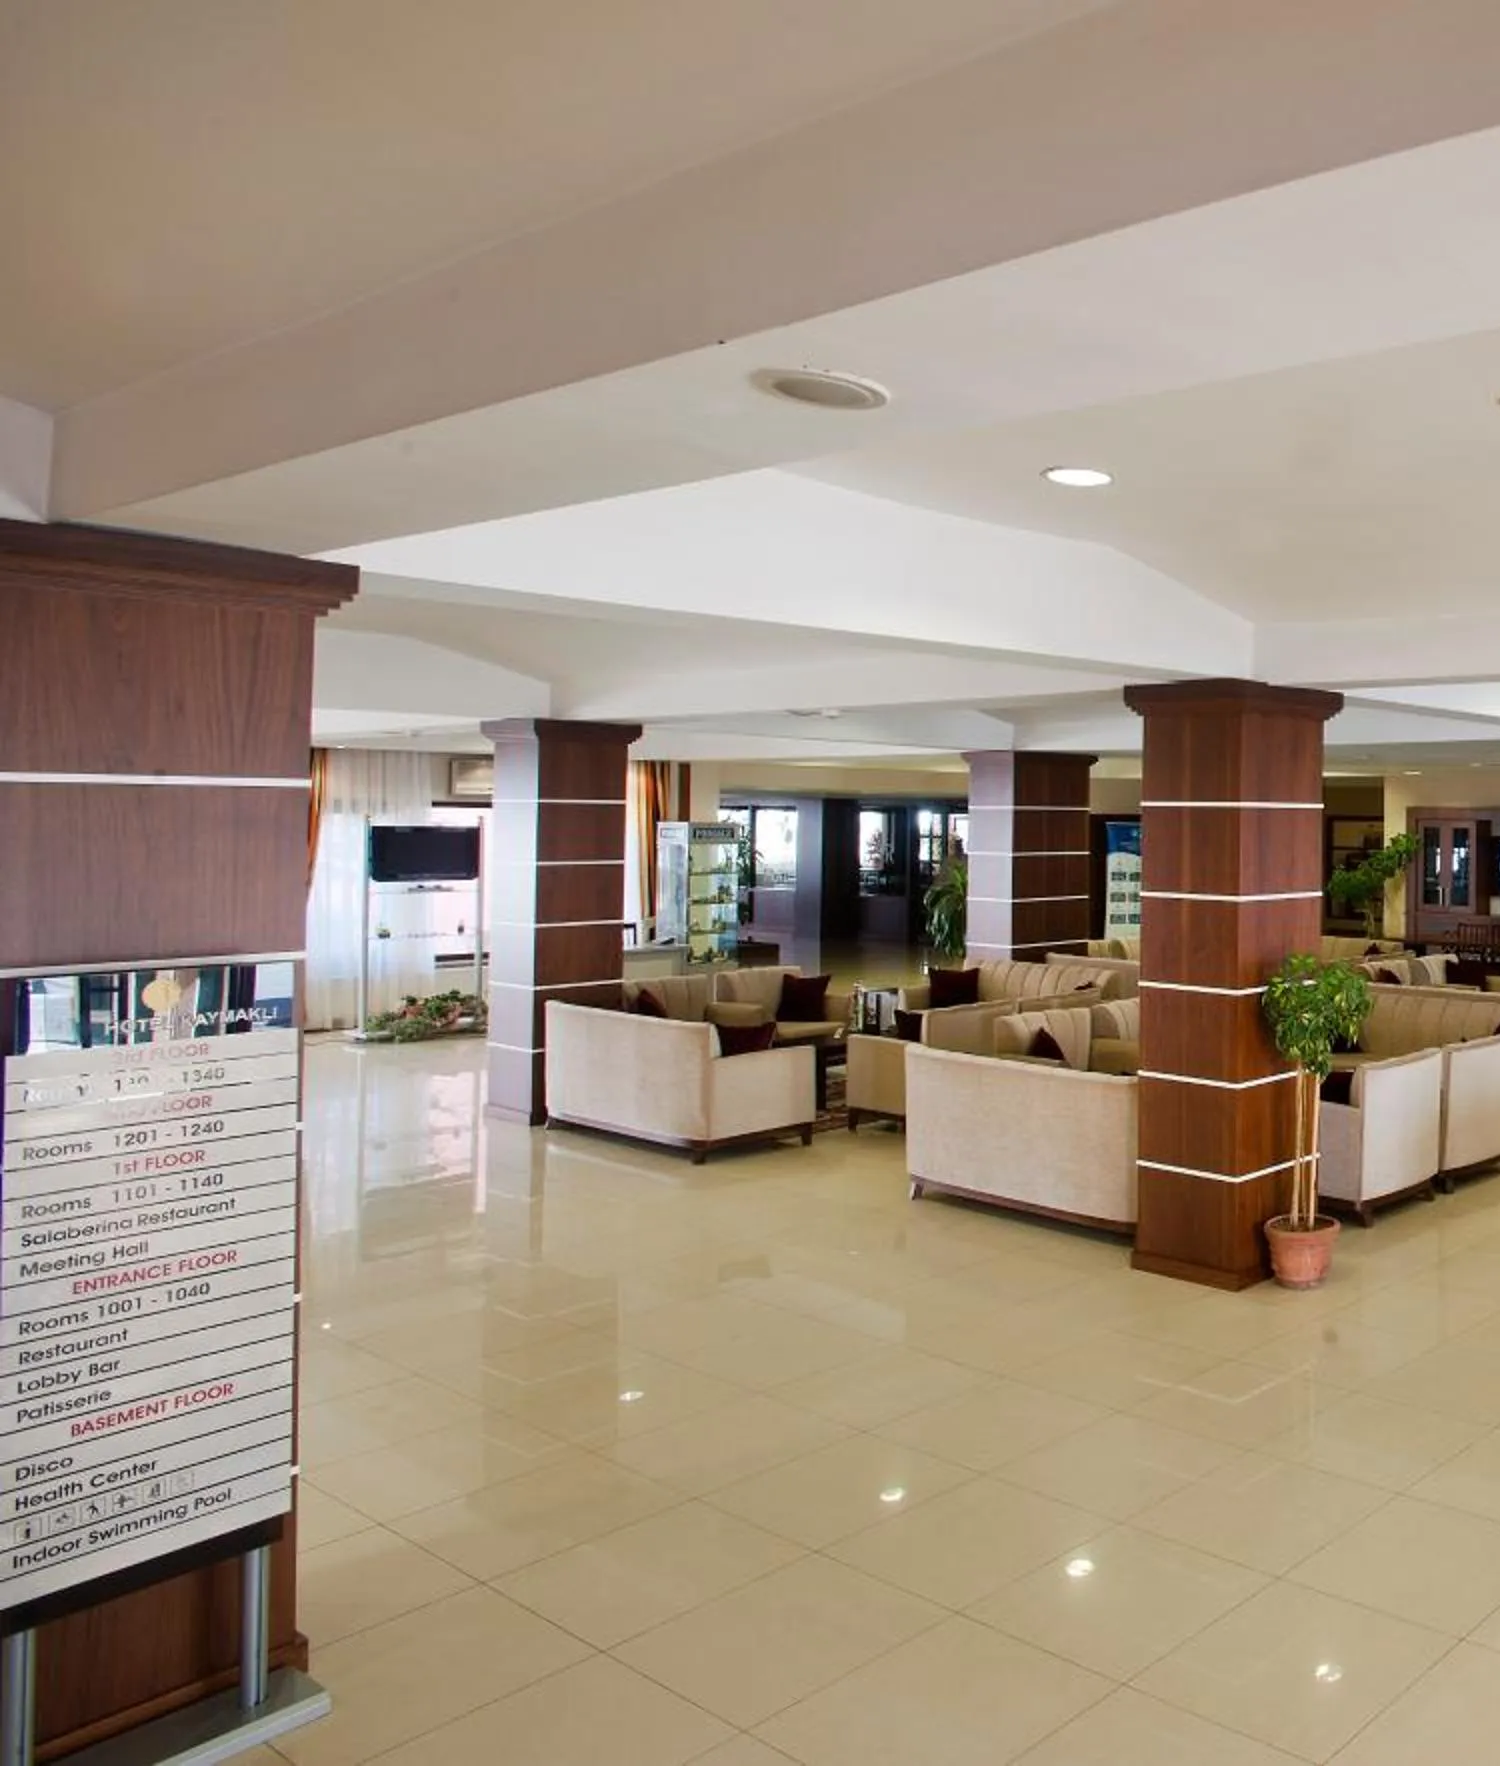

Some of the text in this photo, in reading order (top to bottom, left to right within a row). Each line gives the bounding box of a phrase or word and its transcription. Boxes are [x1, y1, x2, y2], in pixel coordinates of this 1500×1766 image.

[104, 1007, 278, 1036] HOTEL KAYMAKLI
[150, 1043, 210, 1062] FLOOR
[182, 1067, 225, 1084] 1340
[22, 1139, 93, 1162] Rooms
[113, 1127, 158, 1148] 1201
[181, 1119, 225, 1138] 1240
[112, 1150, 206, 1176] 1st FLOOR
[21, 1197, 92, 1220] Rooms
[112, 1183, 157, 1204] 1101
[180, 1173, 224, 1192] 1140
[137, 1198, 236, 1226] Restaurant
[19, 1240, 150, 1278] Meeting Hall
[72, 1250, 238, 1295] ENTRANCE FLOOR
[18, 1308, 90, 1336] Rooms
[98, 1297, 143, 1318] 1001
[166, 1282, 211, 1303] 1040
[18, 1328, 129, 1365] Restaurant
[17, 1359, 121, 1395] Lobby Bar
[17, 1390, 112, 1423] Patisserie
[70, 1382, 234, 1438] BASEMENT FLOOR
[15, 1456, 74, 1482] Disco
[15, 1459, 158, 1511] Health Center
[12, 1488, 232, 1569] Indoor Swimming Pool
